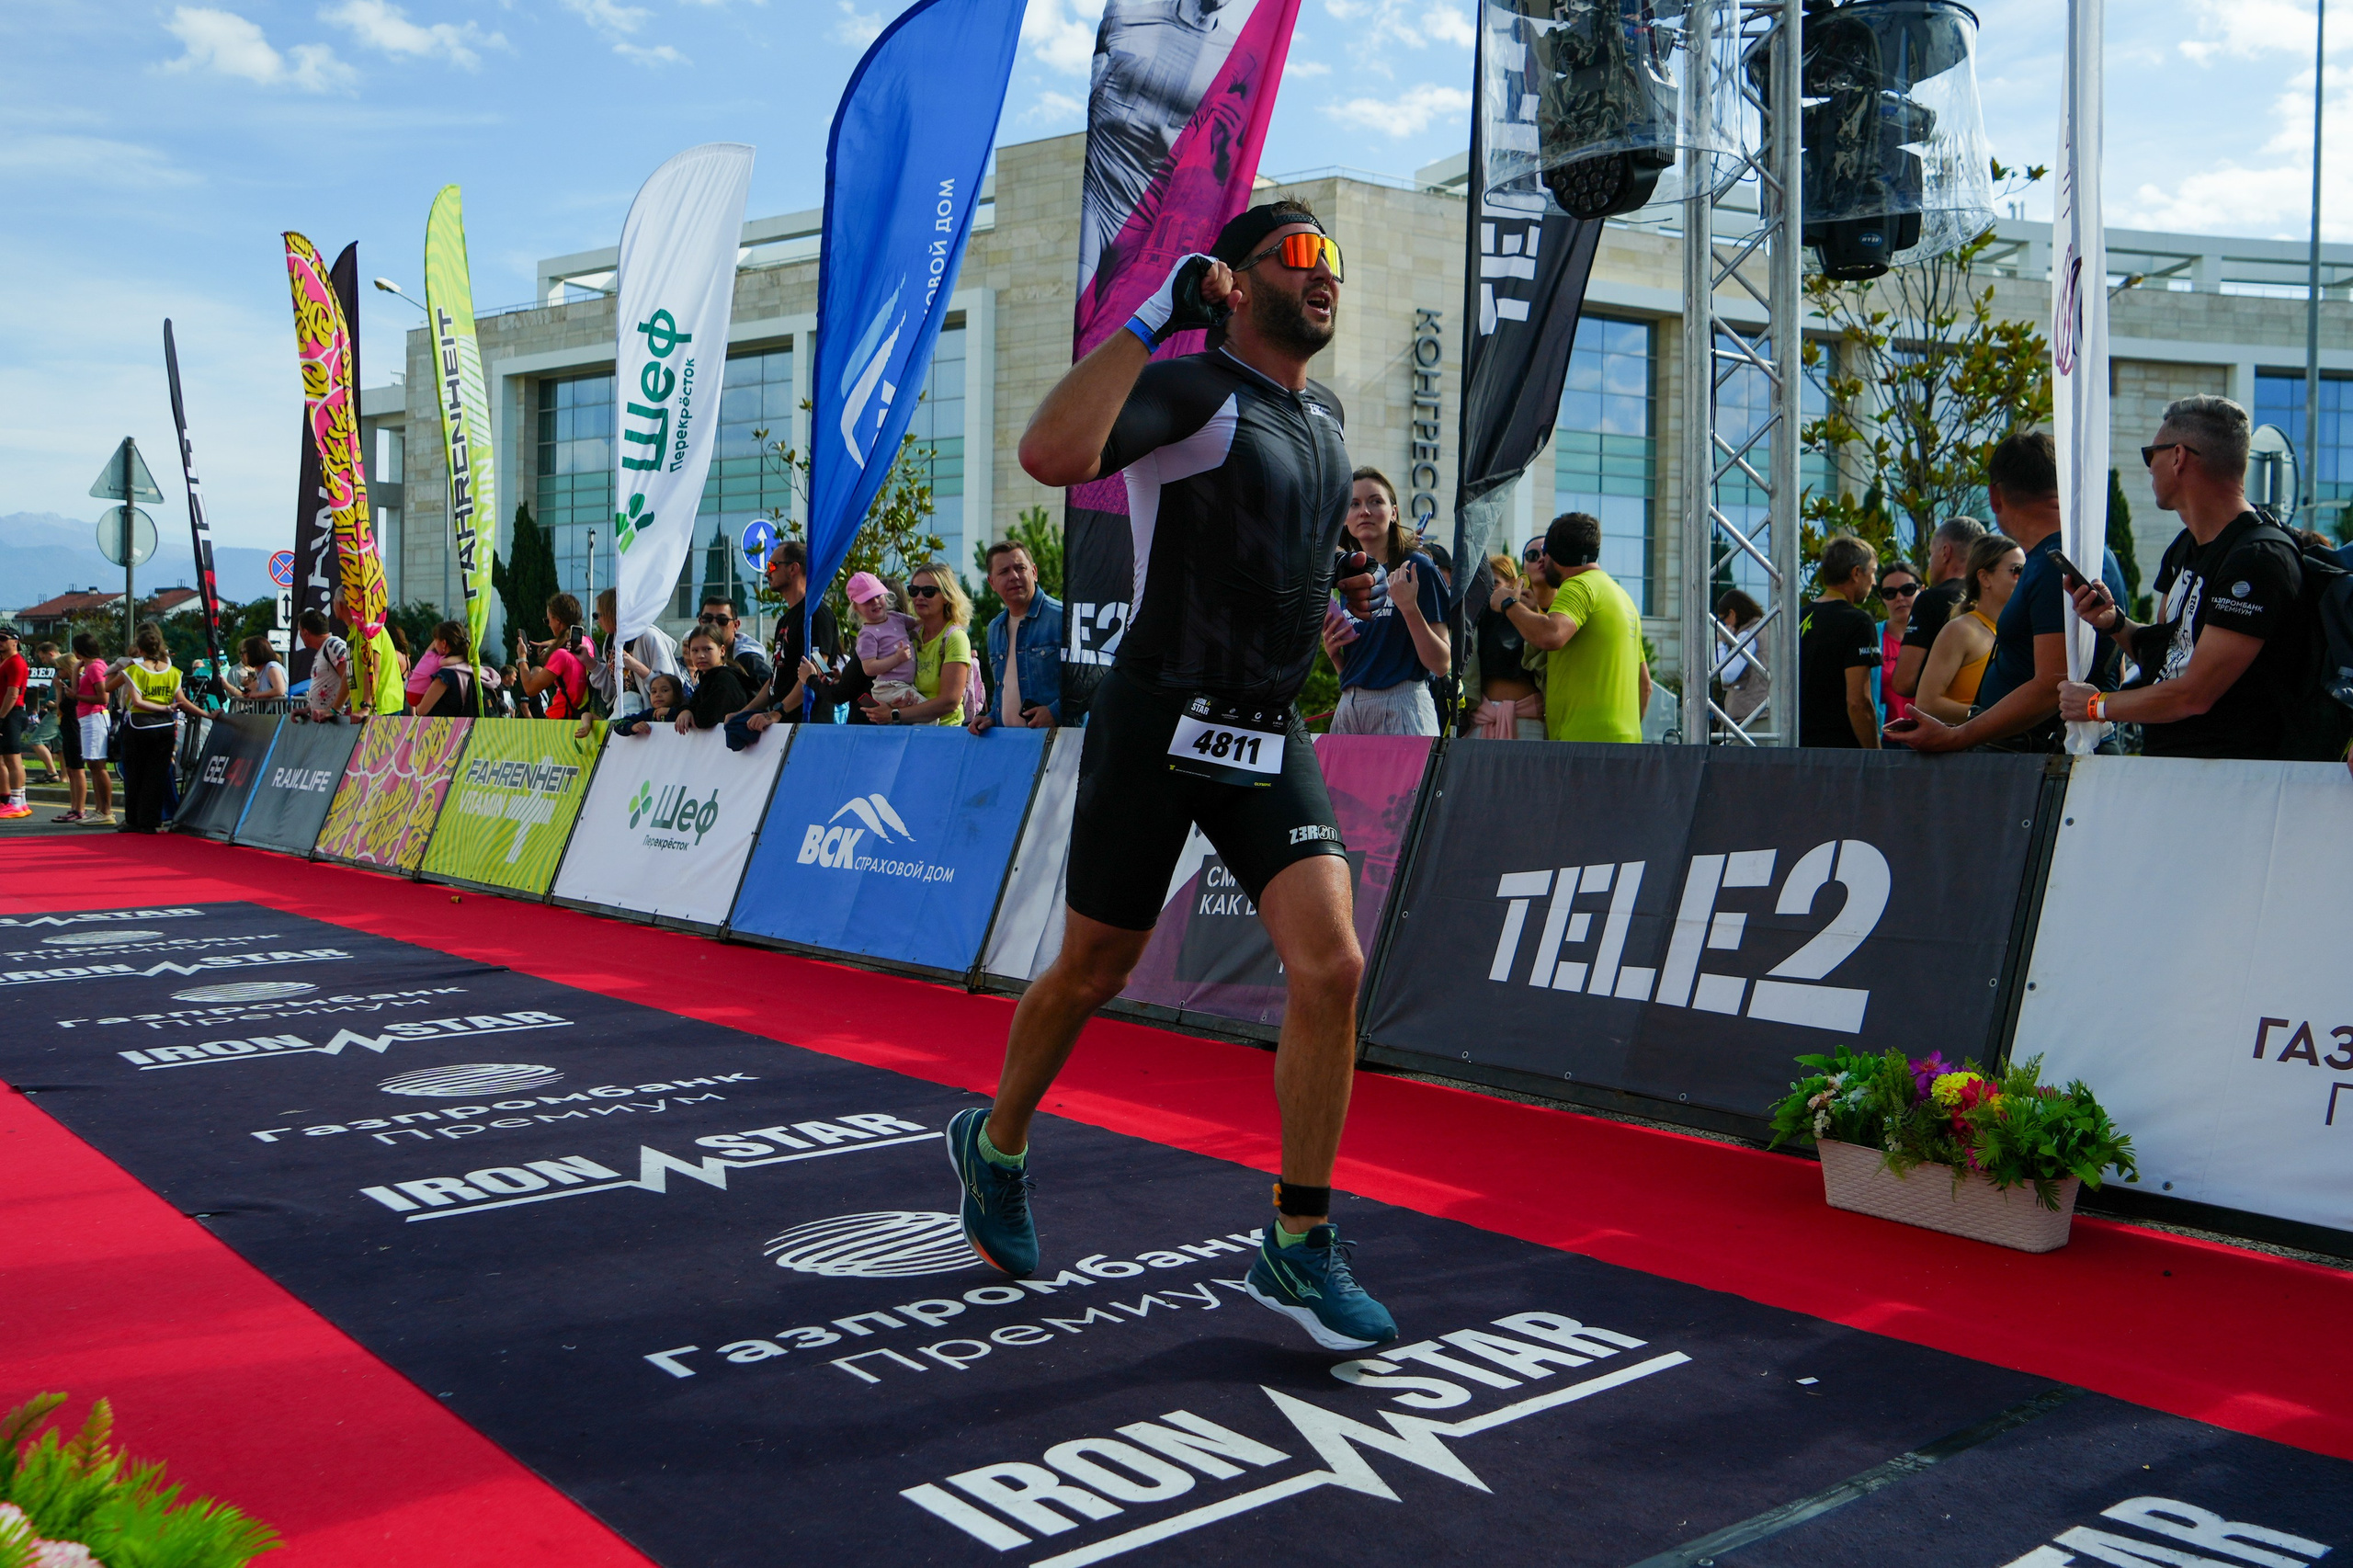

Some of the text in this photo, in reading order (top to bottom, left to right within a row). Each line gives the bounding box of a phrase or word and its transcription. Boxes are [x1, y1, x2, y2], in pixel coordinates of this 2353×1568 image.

[923, 178, 955, 321] ОВОЙ ДОМ
[621, 308, 692, 472] Шеф
[669, 358, 695, 472] Перекрёсток
[1412, 308, 1443, 519] КОНГРЕСС
[437, 308, 477, 599] FAHRENHEIT
[2188, 596, 2198, 615] 2023
[2211, 597, 2264, 612] ГАЗПРОМБАНК
[2215, 603, 2253, 617] ПРЕМИУМ
[1061, 601, 1130, 667] E2
[28, 666, 56, 678] BED
[1191, 703, 1210, 716] STAR
[1192, 730, 1262, 766] 4811
[465, 758, 579, 795] FAHRENHEIT
[459, 790, 508, 817] VITAMIN
[650, 783, 719, 846] Шеф
[643, 835, 690, 851] Перекрёсток
[796, 824, 865, 869] ВСК
[855, 856, 955, 883] СТРАХОВОЙ ДОМ
[75, 908, 201, 919] STAR
[1199, 893, 1243, 915] КАК
[199, 949, 347, 965] STAR
[1488, 839, 1893, 1034] TELE2
[56, 986, 470, 1029] Газпромбанк
[145, 998, 431, 1030] Премиум
[118, 1011, 567, 1065] IRON STAR
[250, 1072, 761, 1143] Газпромбанк
[370, 1092, 727, 1146] Премиум
[358, 1112, 929, 1212] IRON STAR
[643, 1227, 1266, 1379] Газпромбанк
[898, 1311, 1649, 1553] IRON STAR
[1998, 1496, 2335, 1568] AR
